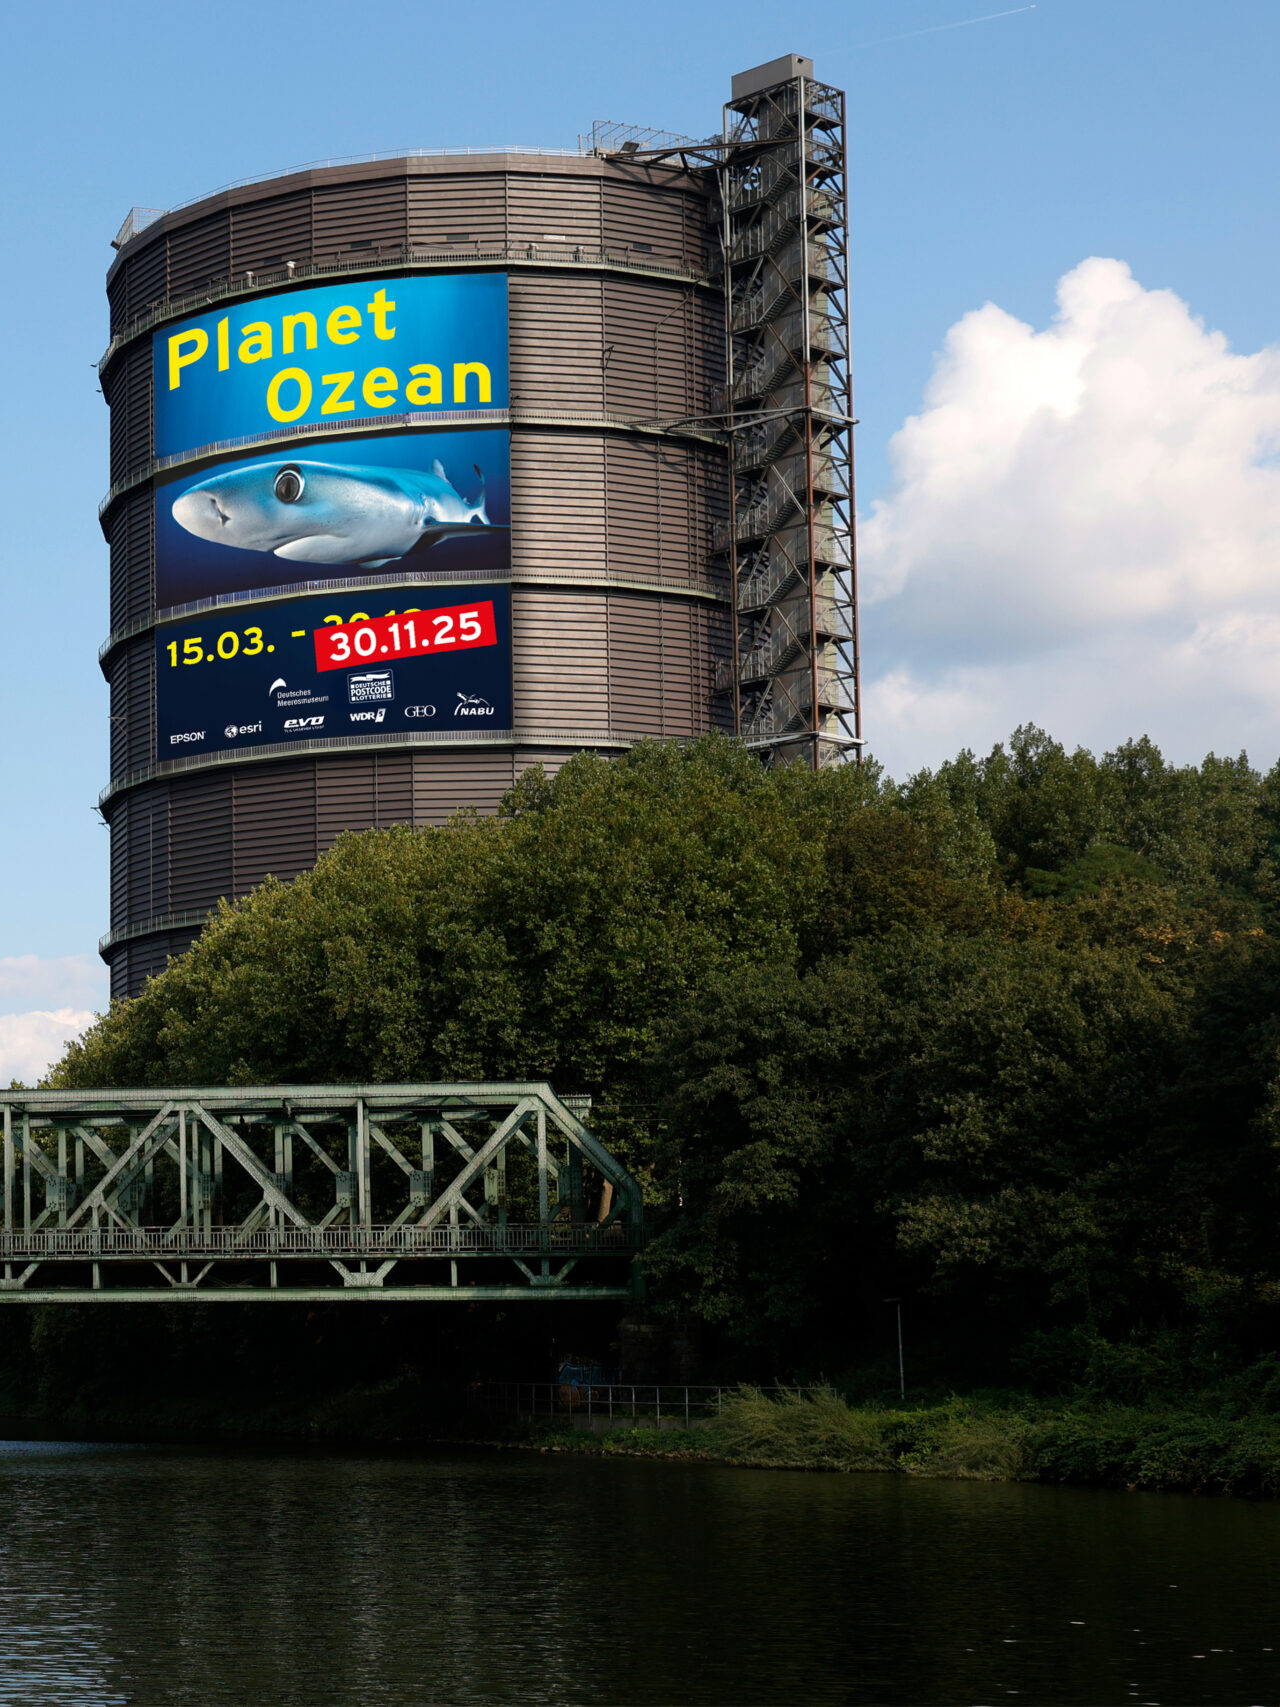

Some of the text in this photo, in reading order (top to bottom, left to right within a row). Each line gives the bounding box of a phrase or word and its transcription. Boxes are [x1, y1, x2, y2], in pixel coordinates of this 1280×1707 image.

[169, 288, 396, 391] Planet
[266, 362, 492, 422] Ozean
[329, 611, 482, 662] 30.11.25
[166, 626, 306, 667] 15.03. -
[277, 689, 311, 700] Deutsches
[351, 686, 391, 696] POSTCODE
[277, 695, 329, 707] Meeresmuseum
[404, 705, 437, 718] GEO
[460, 706, 495, 716] NABU
[239, 721, 263, 734] esri
[283, 716, 325, 728] evo
[170, 731, 205, 745] EPSON
